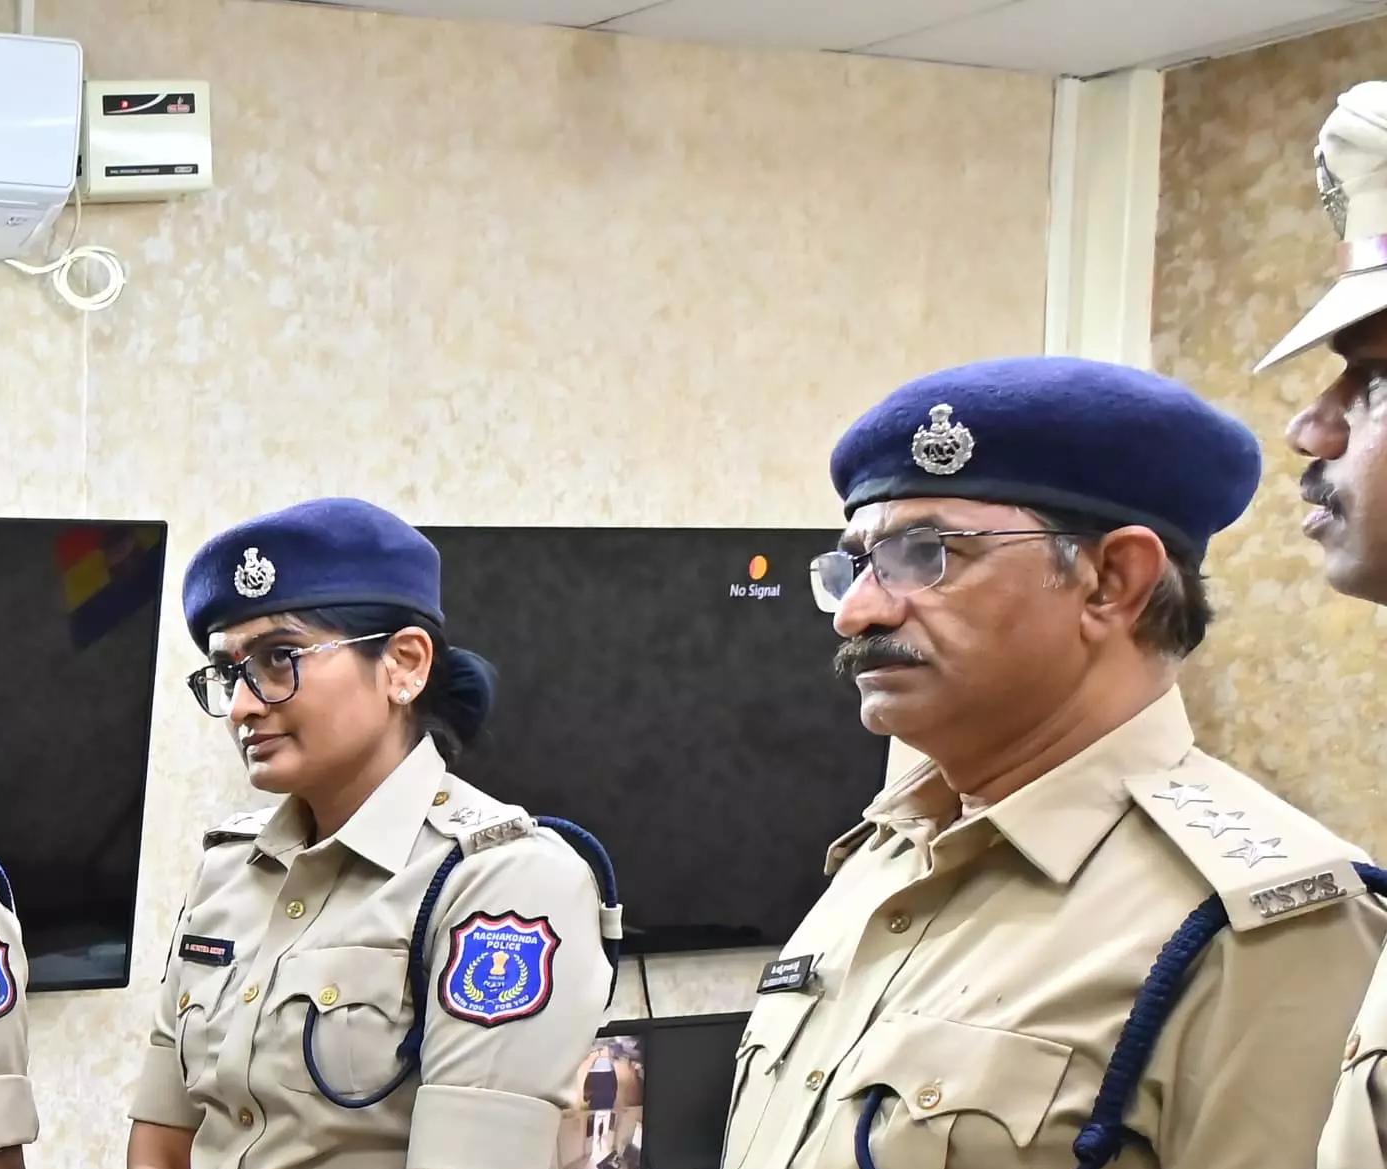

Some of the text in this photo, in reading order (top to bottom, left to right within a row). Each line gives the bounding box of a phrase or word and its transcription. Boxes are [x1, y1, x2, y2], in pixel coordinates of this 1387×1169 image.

[729, 583, 781, 600] No Signal
[473, 932, 538, 945] RACHAKONDA
[486, 940, 522, 952] POLICE
[468, 1002, 485, 1012] YOU
[513, 994, 530, 1007] YOU
